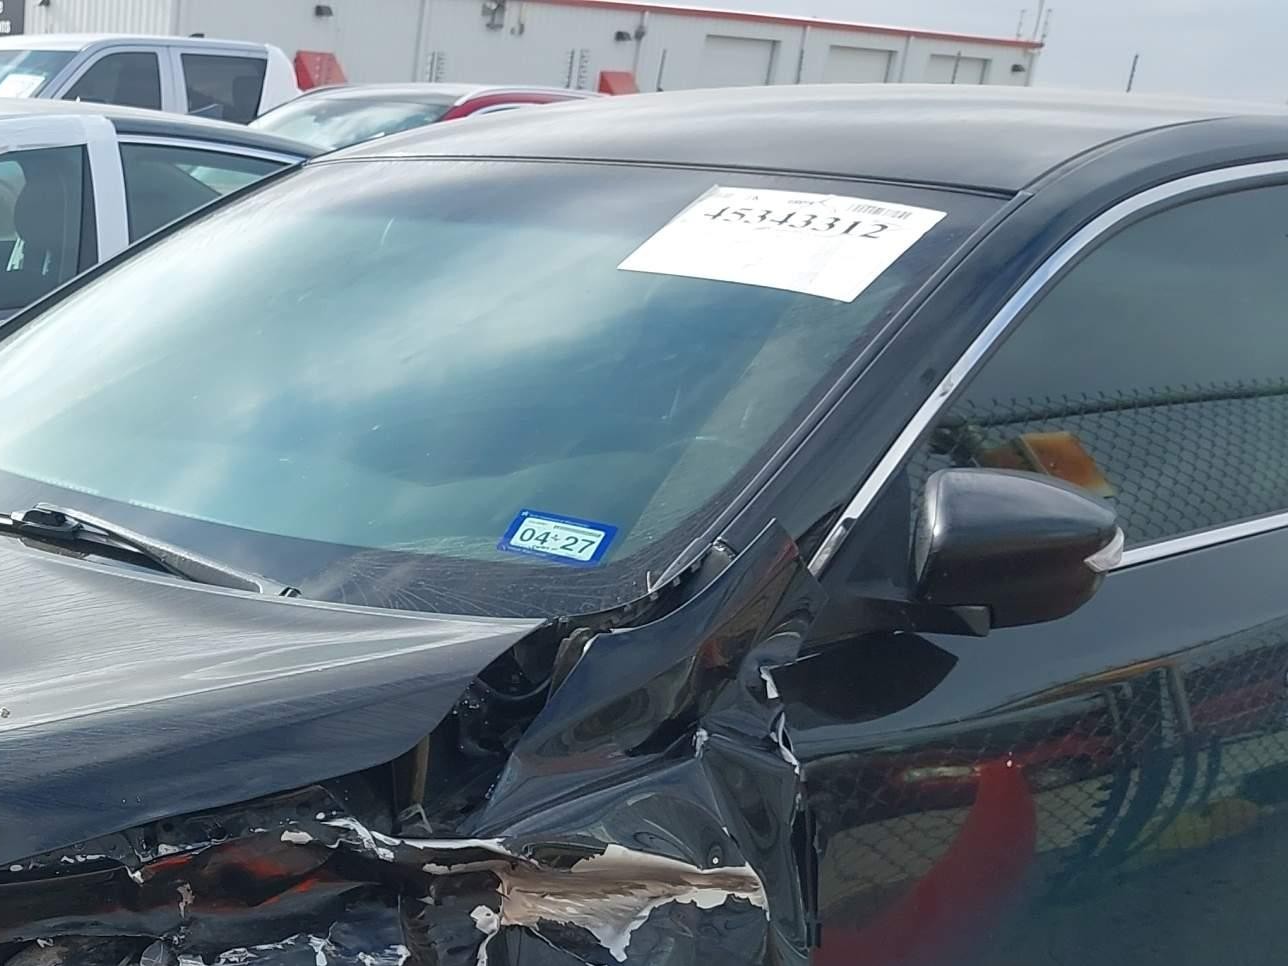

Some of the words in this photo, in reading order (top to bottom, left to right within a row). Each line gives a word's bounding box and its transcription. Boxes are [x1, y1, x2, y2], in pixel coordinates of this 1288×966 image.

[703, 205, 889, 240] 45343312
[518, 527, 551, 546] 04
[559, 535, 595, 554] 27
